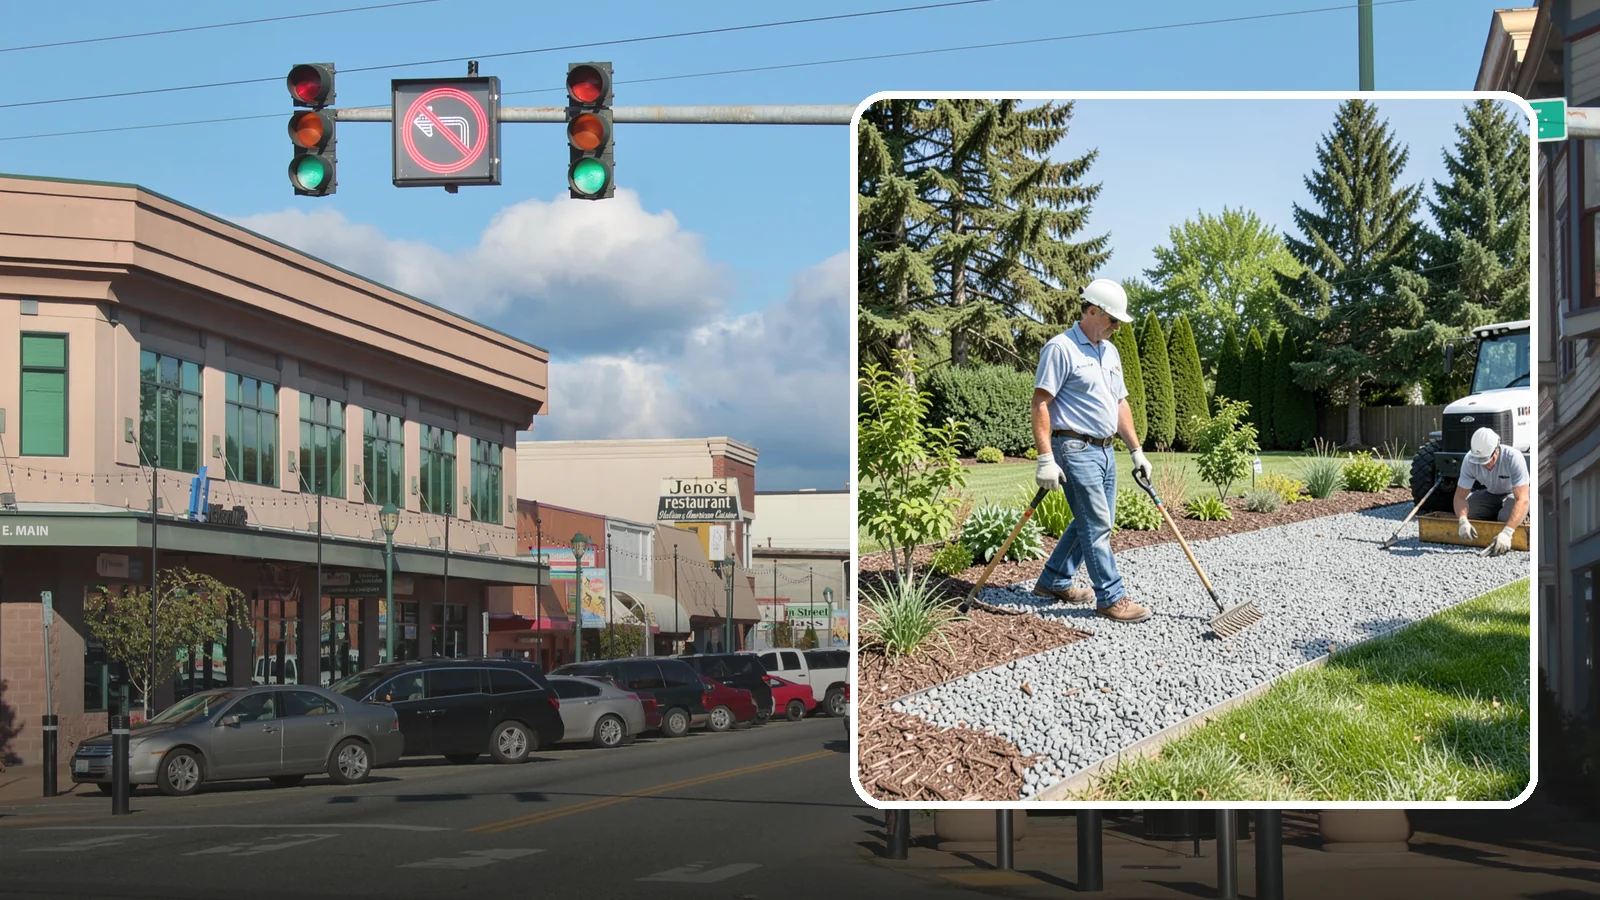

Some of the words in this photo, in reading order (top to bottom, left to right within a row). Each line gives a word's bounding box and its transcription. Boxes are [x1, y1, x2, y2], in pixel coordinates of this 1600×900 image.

[669, 480, 727, 495] Jeno's
[665, 496, 731, 509] restaurant
[658, 509, 681, 519] Italian
[686, 509, 714, 519] American
[715, 509, 737, 519] Cuisine
[2, 525, 13, 536] E.
[15, 525, 49, 536] MAIN
[797, 607, 828, 616] Street
